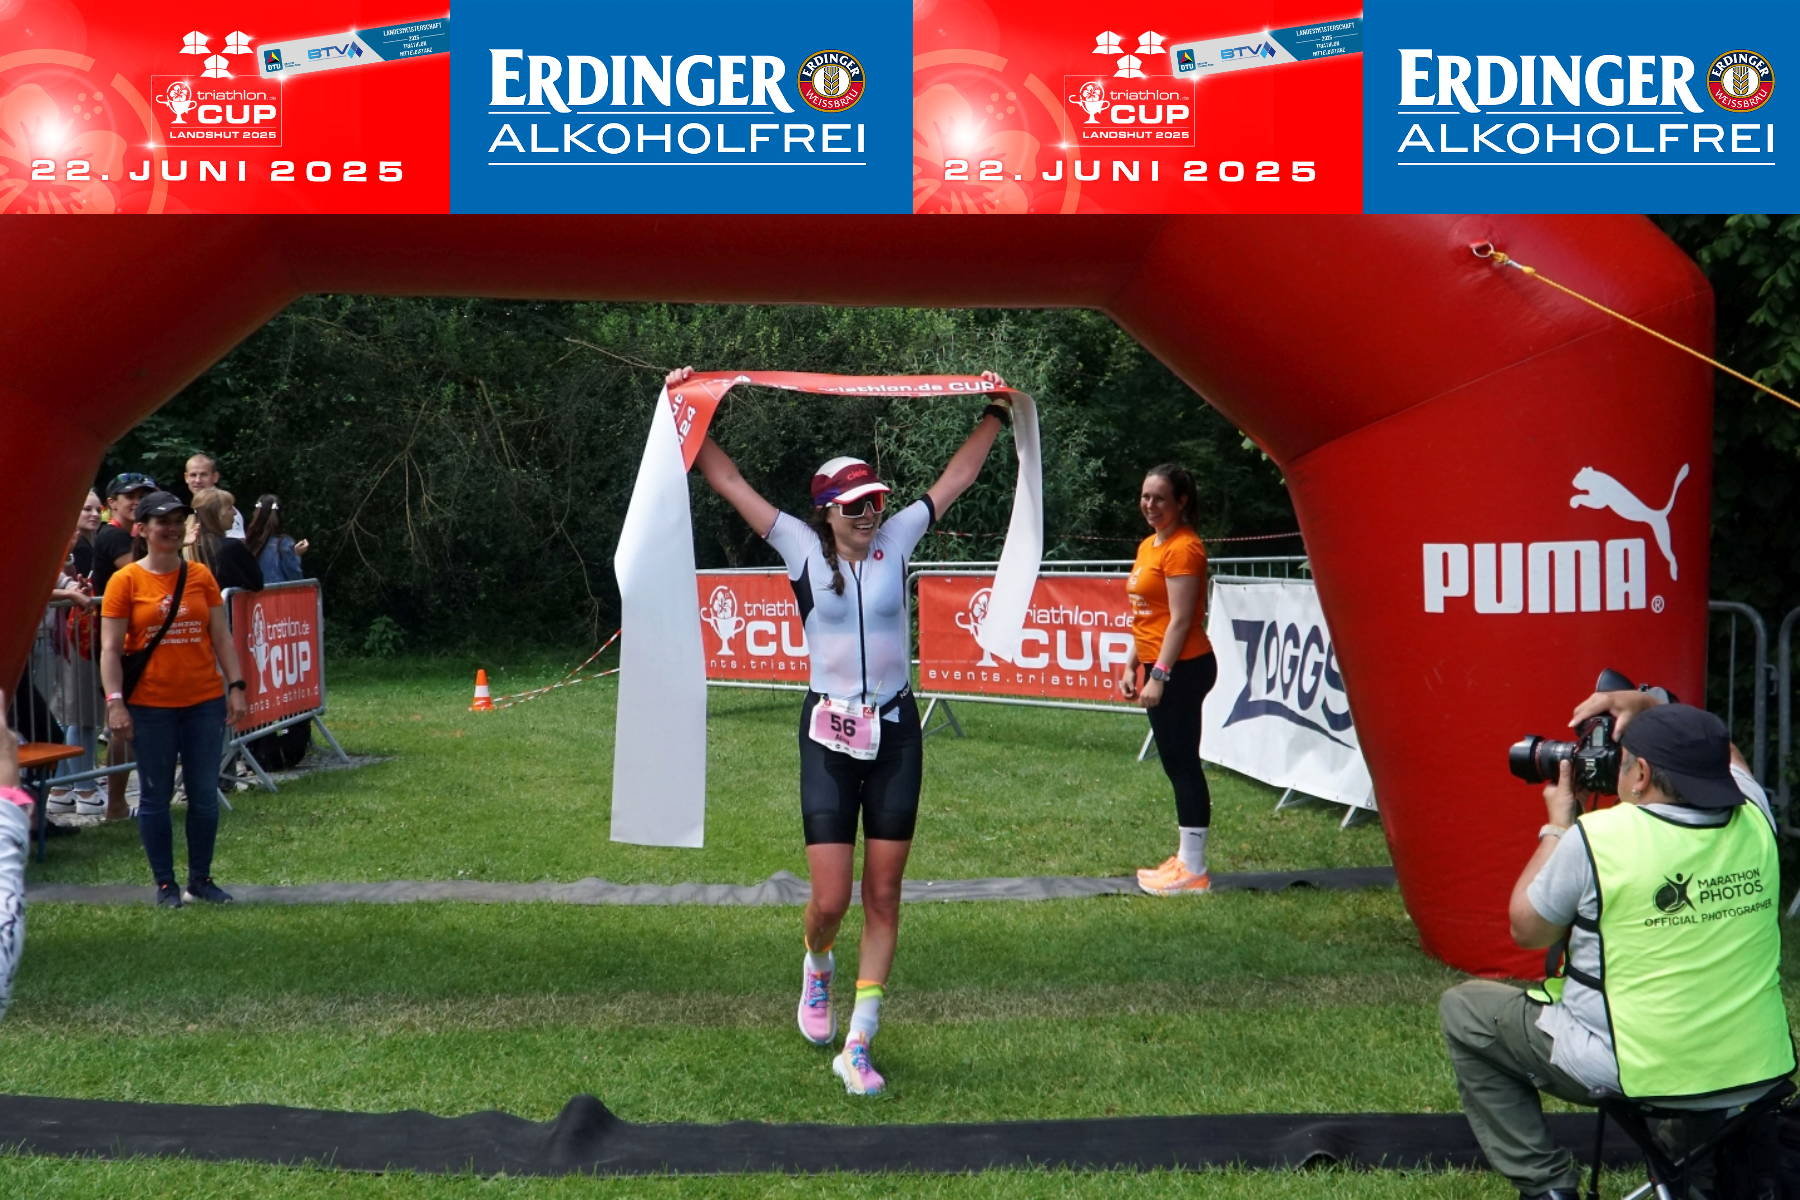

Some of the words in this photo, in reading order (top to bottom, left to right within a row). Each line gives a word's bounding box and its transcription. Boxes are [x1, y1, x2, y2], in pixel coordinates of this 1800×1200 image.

[949, 381, 995, 392] CUP
[1423, 538, 1647, 614] PUMA
[270, 640, 311, 689] CUP
[1012, 628, 1136, 673] CUP
[1222, 618, 1354, 735] ZOGGS
[830, 713, 857, 738] 56
[1697, 868, 1761, 889] MARATHON
[1700, 880, 1764, 904] PHOTOS
[1644, 914, 1698, 927] OFFICIAL
[1701, 898, 1773, 923] PHOTOGRAPHER
